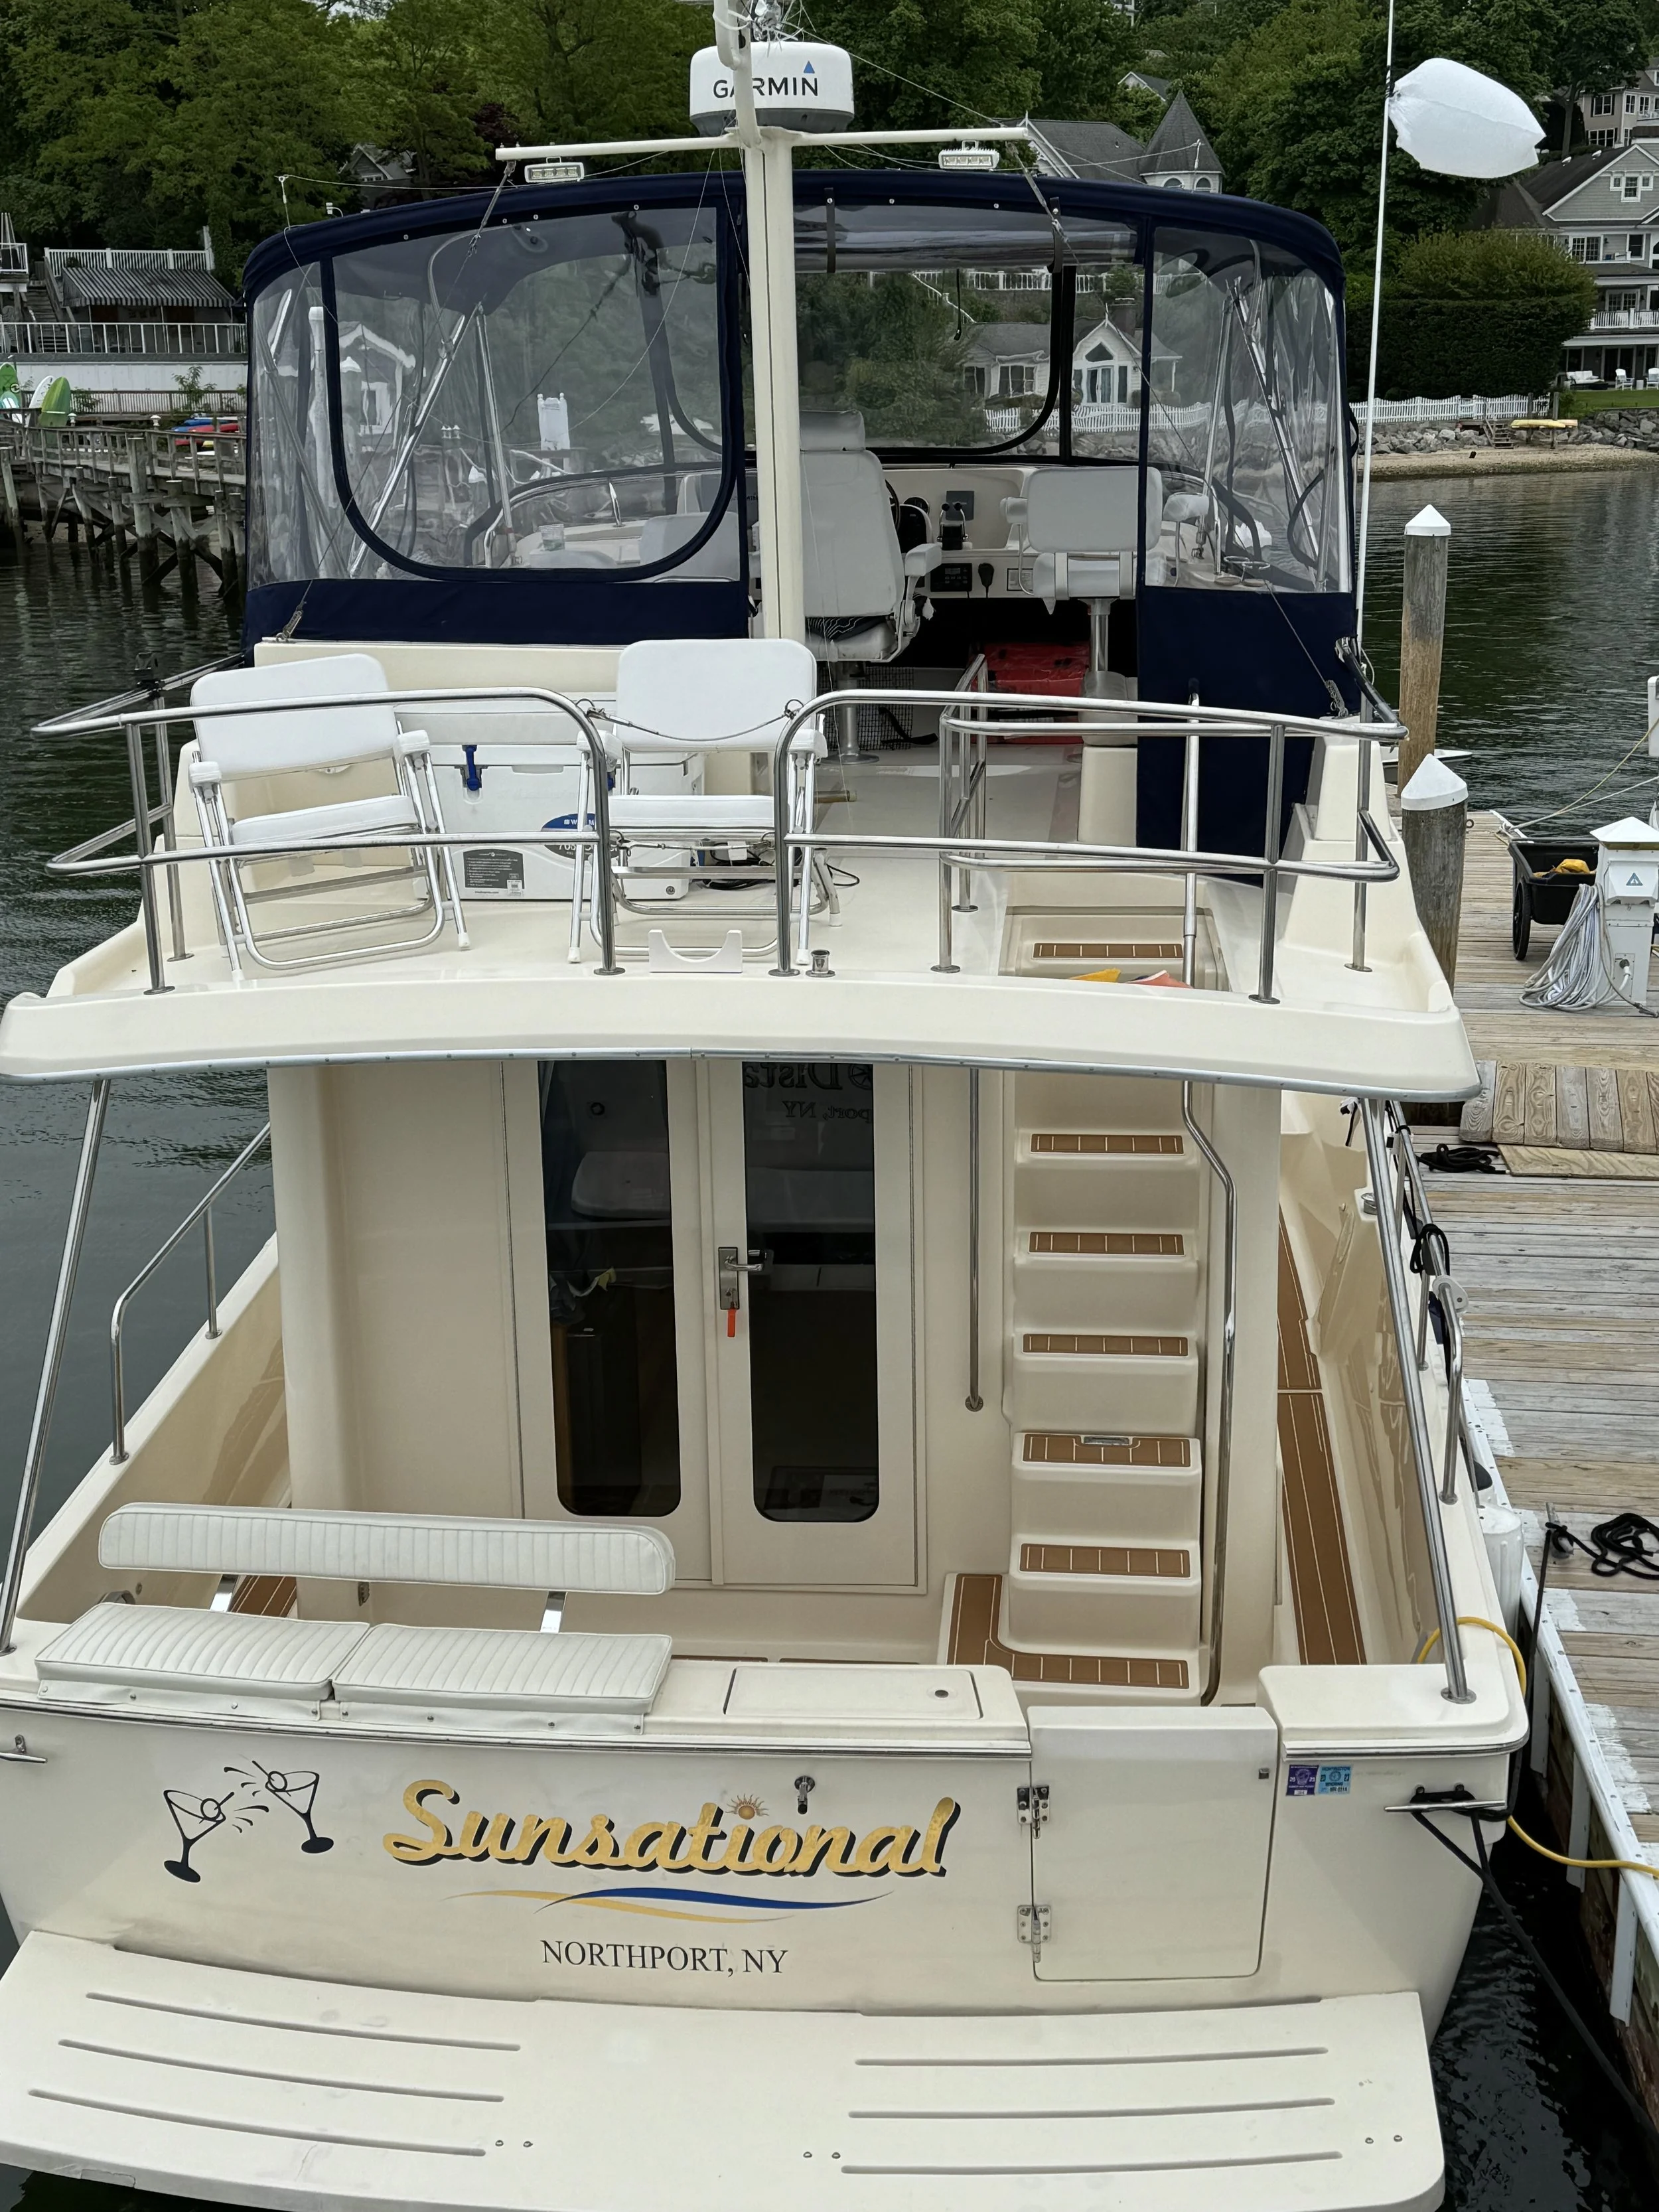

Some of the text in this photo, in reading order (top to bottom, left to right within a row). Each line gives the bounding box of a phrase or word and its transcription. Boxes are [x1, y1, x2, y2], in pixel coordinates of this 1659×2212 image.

[713, 77, 818, 98] GRMIN
[382, 1779, 962, 1878] Sunsational
[541, 1939, 790, 1977] NORTHPORT, NY
